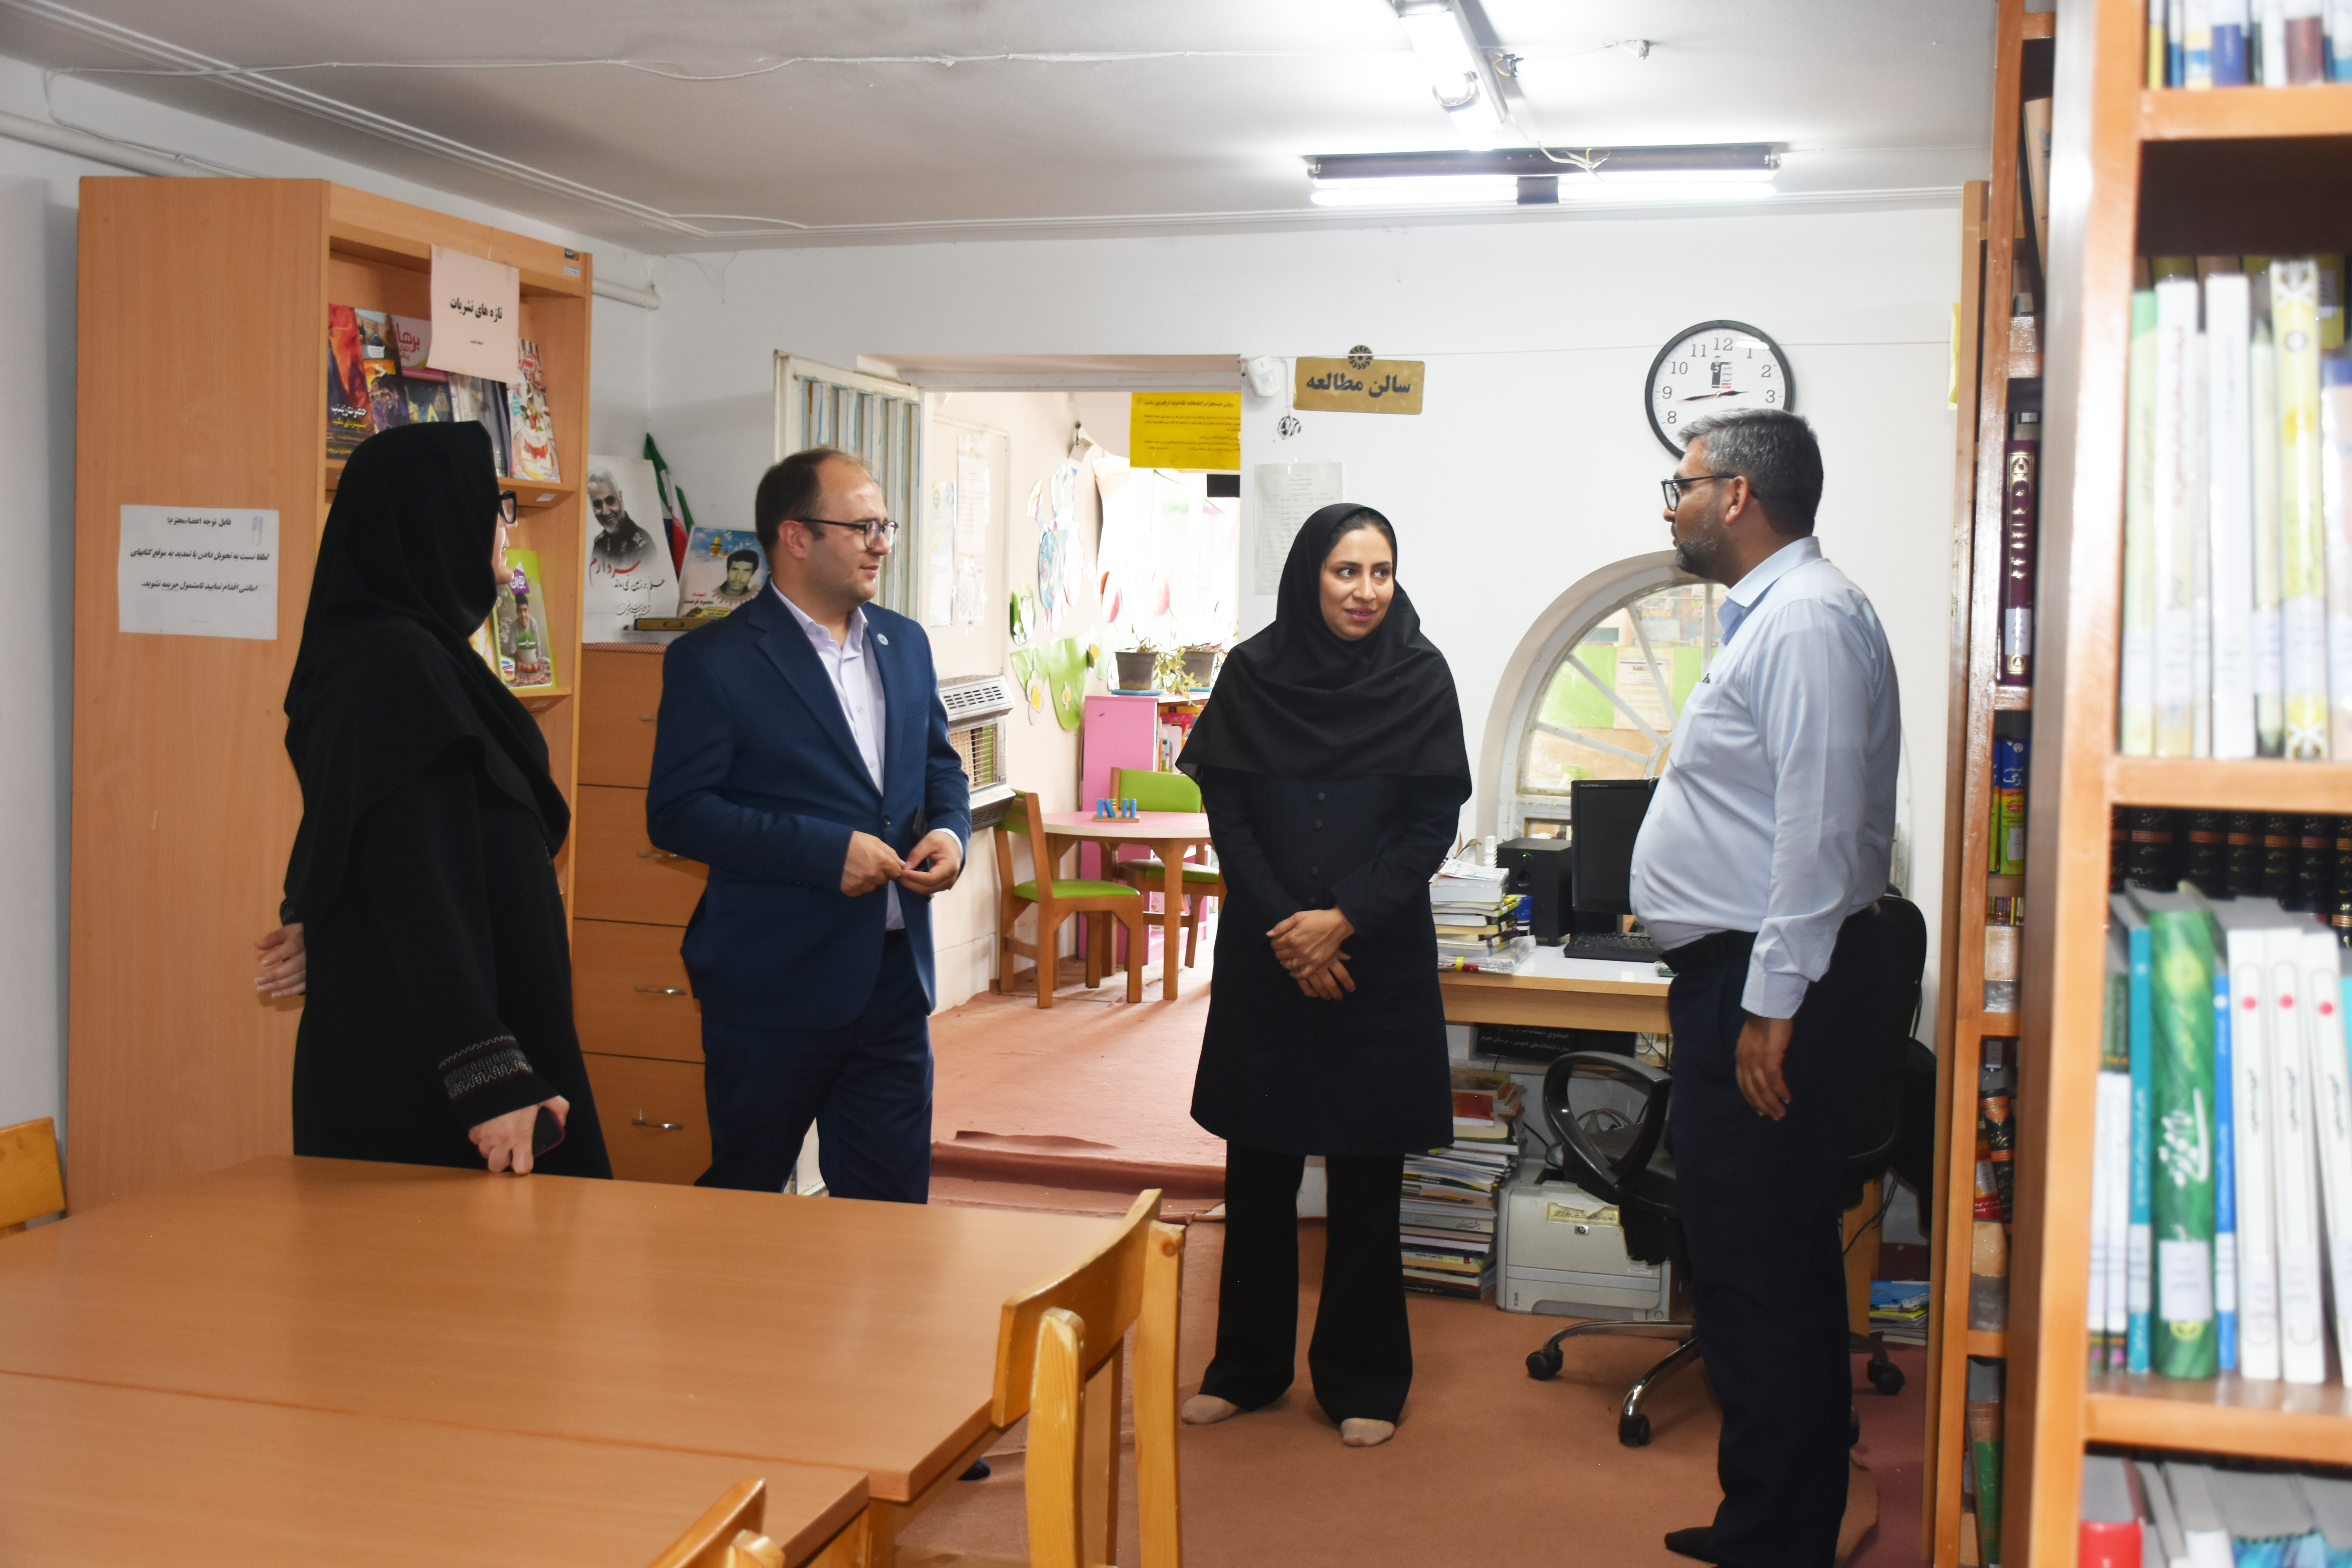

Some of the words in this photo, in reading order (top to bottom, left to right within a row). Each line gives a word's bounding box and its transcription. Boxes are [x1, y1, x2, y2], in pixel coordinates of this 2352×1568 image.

[450, 297, 474, 315] نشریات
[475, 303, 488, 318] های
[490, 307, 503, 322] تازه
[1691, 344, 1707, 357] 11
[1713, 338, 1733, 351] 12
[1746, 347, 1753, 359] 1
[1671, 361, 1688, 374] 10
[1761, 365, 1772, 378] 2
[1307, 372, 1363, 392] مطالعه
[1369, 374, 1411, 397] سالن
[1662, 386, 1672, 399] 9
[1765, 390, 1775, 403] 3
[1667, 411, 1677, 424] 8
[203, 519, 217, 527] توجه
[219, 518, 232, 527] قابل
[130, 548, 153, 557] کتابهای
[152, 549, 167, 558] موقع
[192, 550, 197, 559] یا
[198, 551, 213, 560] دادن
[214, 552, 233, 561] تحویل
[590, 558, 641, 588] سردارم
[205, 583, 223, 591] نمایید
[222, 583, 240, 592] اقدام
[239, 584, 258, 593] امانتی
